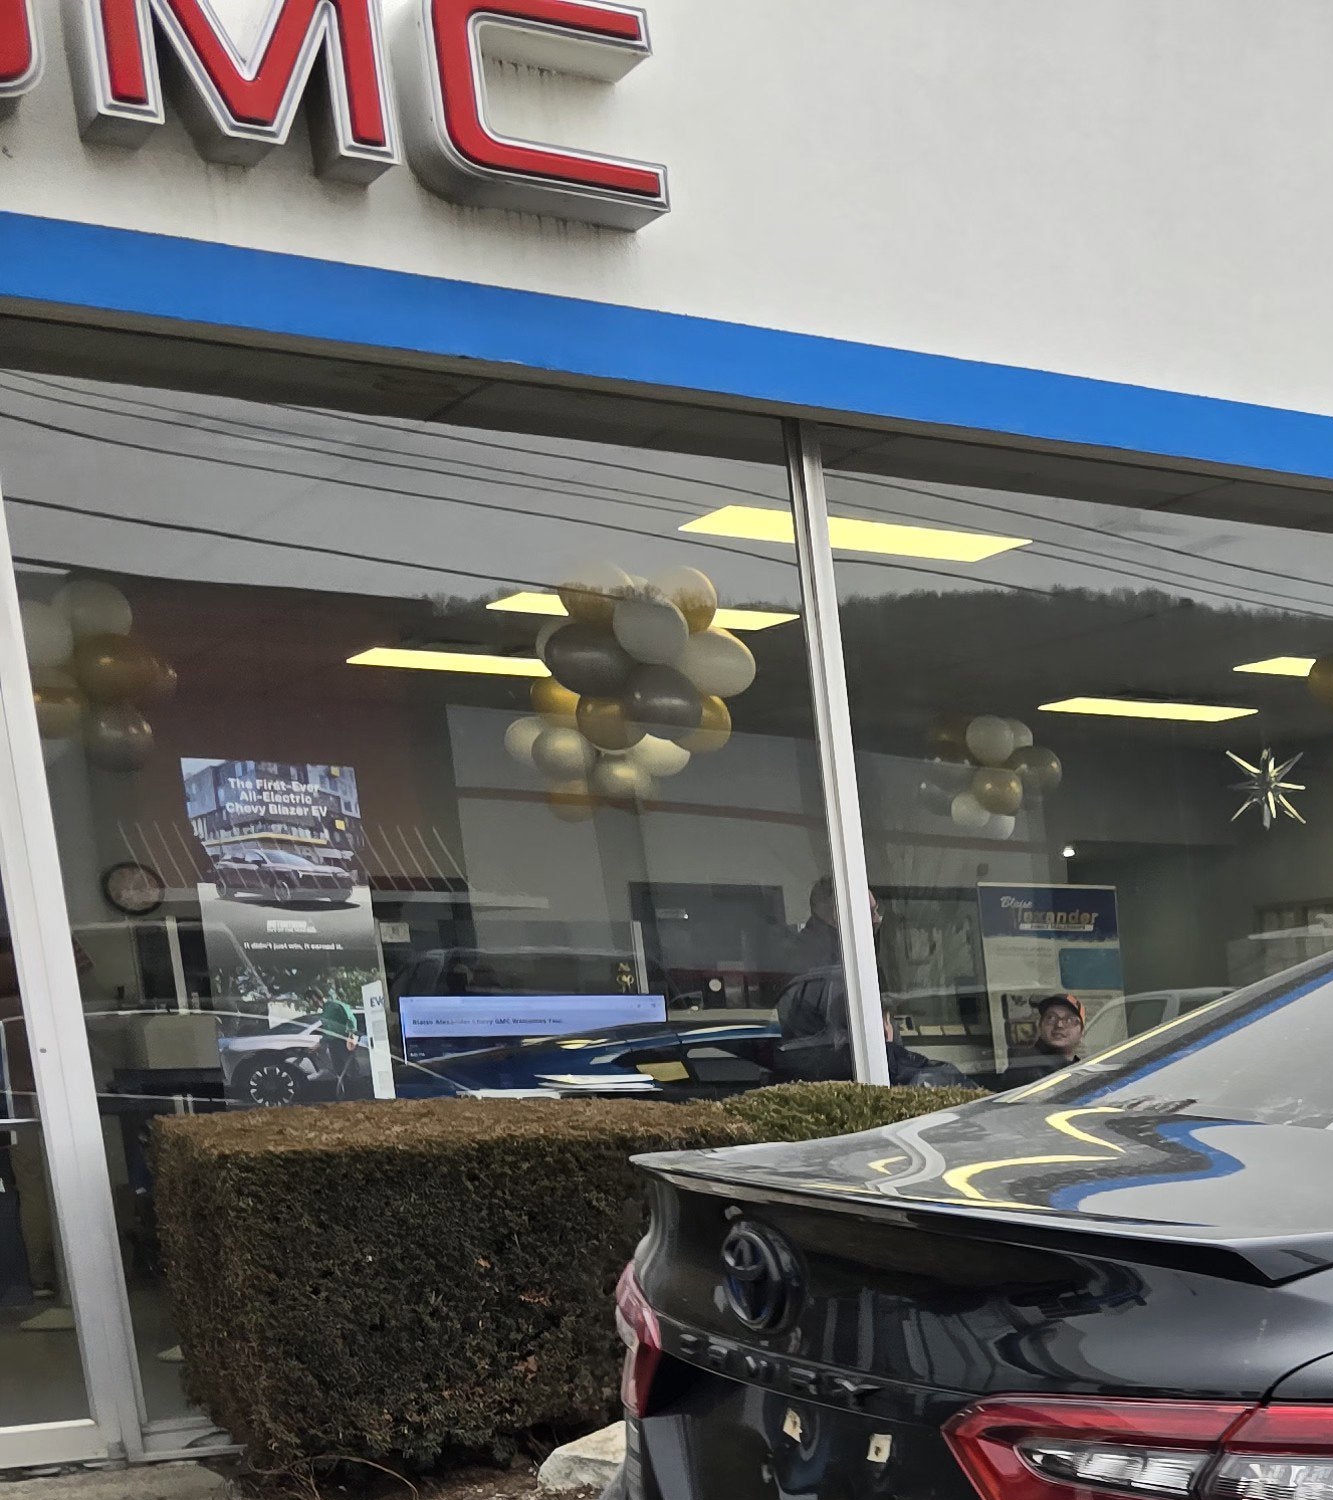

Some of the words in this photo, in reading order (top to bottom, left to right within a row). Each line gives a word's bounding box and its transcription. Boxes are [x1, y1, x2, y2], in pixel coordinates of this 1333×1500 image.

[0, 0, 670, 231] MC
[228, 777, 253, 789] The
[240, 790, 312, 804] All-Electric
[225, 802, 266, 816] Chevy
[268, 803, 309, 816] Blazer
[311, 805, 328, 817] EV
[1008, 908, 1100, 927] lexander
